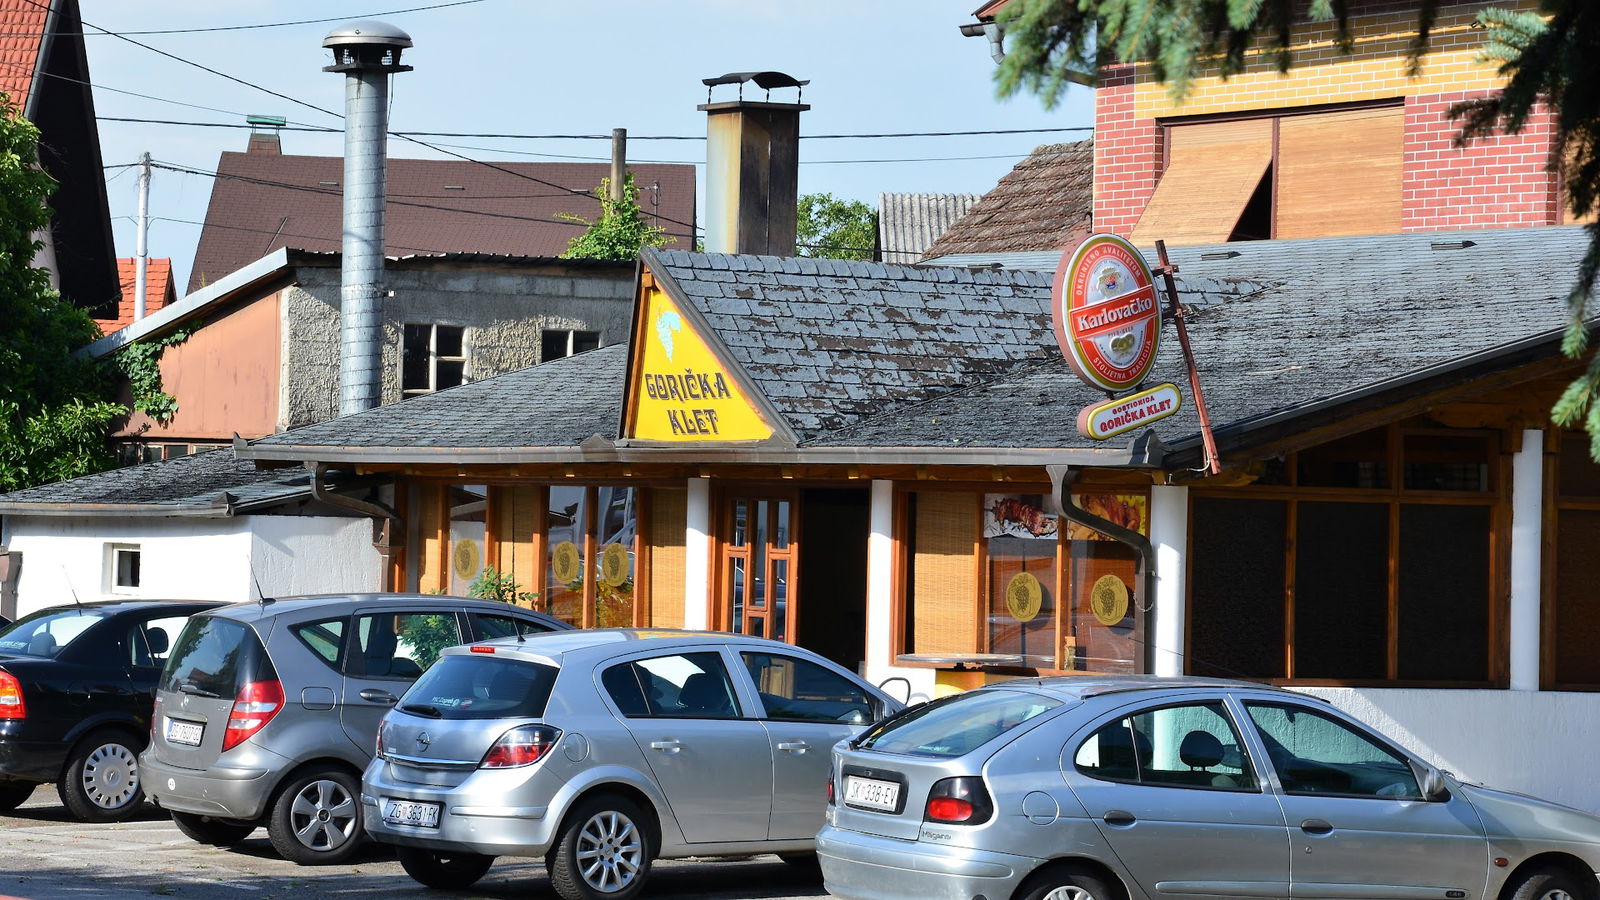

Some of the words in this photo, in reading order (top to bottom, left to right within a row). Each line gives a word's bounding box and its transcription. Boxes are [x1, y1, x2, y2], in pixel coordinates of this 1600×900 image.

[1076, 250, 1100, 295] OKRUNJENO
[1101, 246, 1141, 277] KVALITETOM
[1077, 297, 1153, 332] Karlovačko
[1093, 357, 1126, 379] STOLJETNA
[1129, 340, 1152, 376] TRADICIJA
[644, 368, 732, 403] GORIČKA
[667, 409, 719, 435] KLET
[1099, 409, 1146, 433] GORIČKA
[1146, 398, 1171, 416] KLET
[851, 781, 863, 799] SK
[389, 803, 403, 819] ZG
